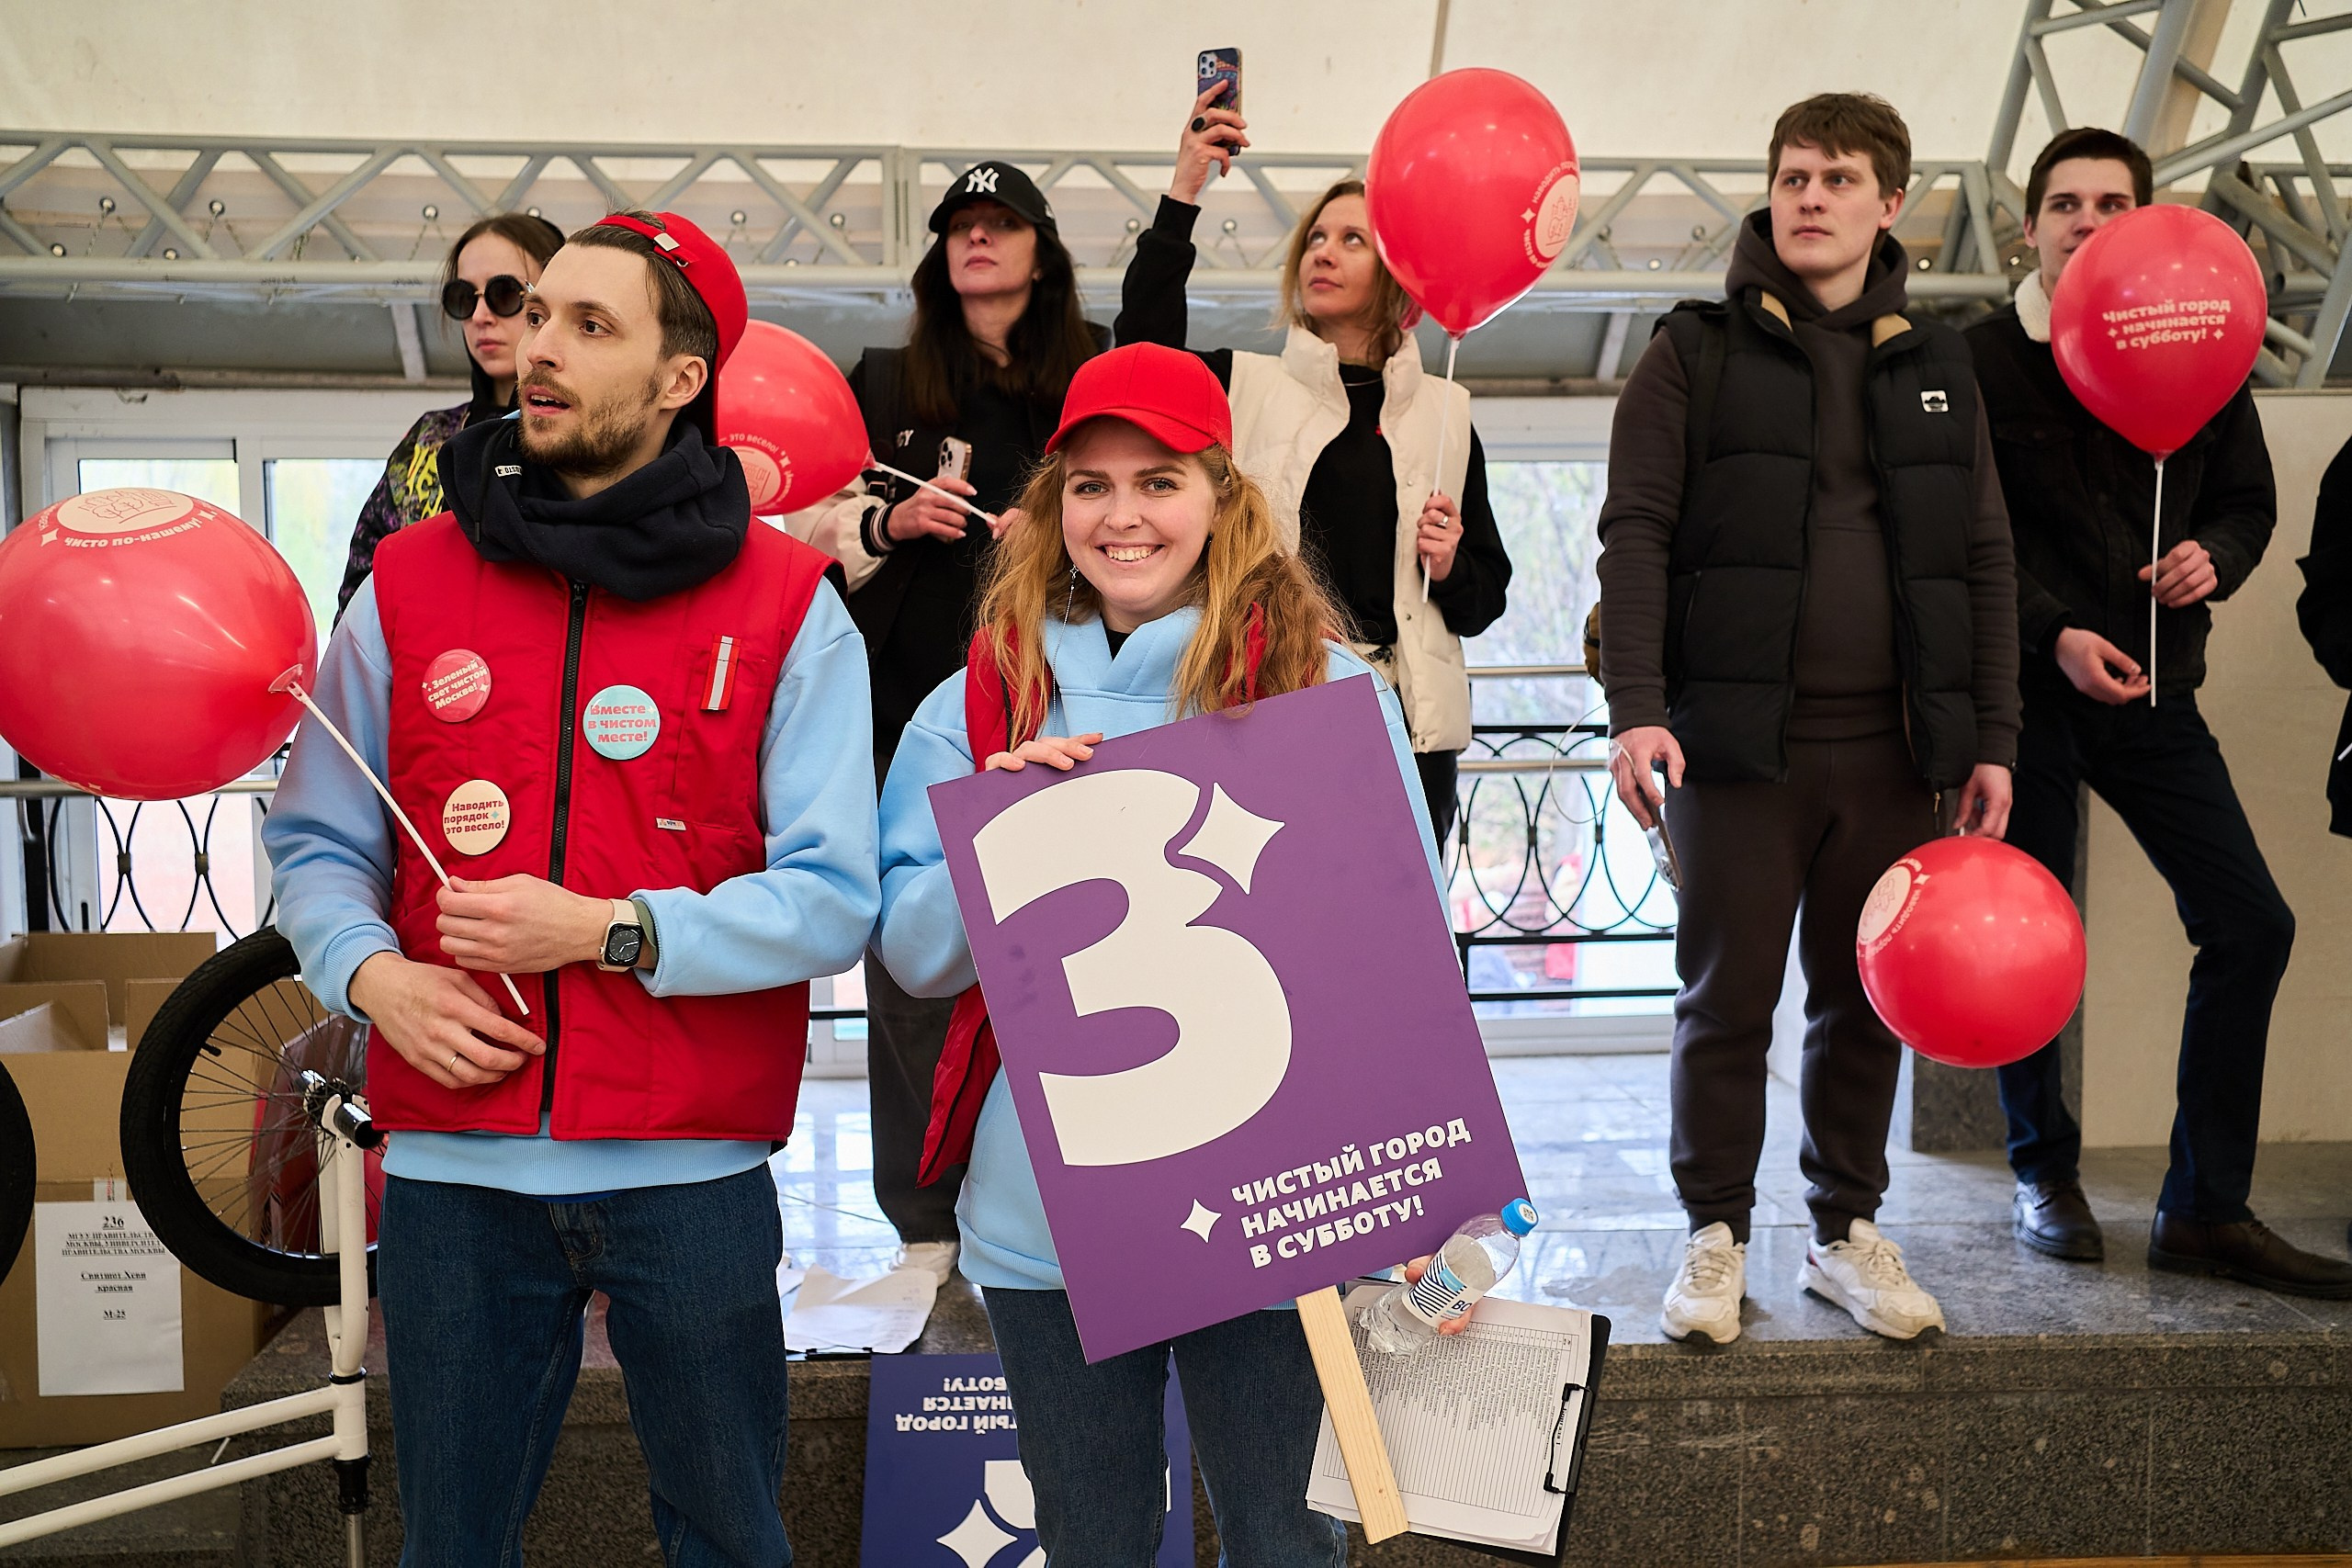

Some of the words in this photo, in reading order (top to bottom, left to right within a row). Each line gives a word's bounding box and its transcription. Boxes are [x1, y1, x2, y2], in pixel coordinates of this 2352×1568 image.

[965, 167, 1000, 193] NY
[2102, 299, 2176, 322] Чистый
[2178, 299, 2231, 314] город
[2122, 315, 2225, 334] начинается
[2116, 340, 2127, 350] в
[2130, 328, 2207, 349] субботу!
[64, 536, 108, 548] чисто
[112, 517, 203, 547] по-нашему!
[428, 686, 450, 702] свет
[450, 666, 488, 689] чистой
[432, 660, 479, 689] Зеленый
[435, 682, 478, 709] Москве!
[590, 705, 646, 715] Вместе
[588, 720, 596, 728] в
[600, 719, 656, 728] чистом
[597, 731, 648, 742] месте!
[452, 800, 503, 812] Наводить
[444, 813, 489, 825] порядок
[446, 826, 462, 834] это
[464, 820, 504, 832] весело!
[1231, 1143, 1365, 1206] ЧИСТЫЙ
[1368, 1117, 1472, 1167] ГОРОД
[1240, 1156, 1443, 1238] НАЧИНАЕТСЯ
[103, 1215, 125, 1228] 236
[1249, 1244, 1272, 1269] В
[1276, 1194, 1425, 1259] СУББОТУ!
[97, 1284, 133, 1292] красная
[943, 1376, 1007, 1393] БОТУ!
[922, 1396, 1013, 1412] НАЕТСЯ
[895, 1414, 968, 1432] ГОРОД
[973, 1415, 1017, 1435] ТЫЙ
